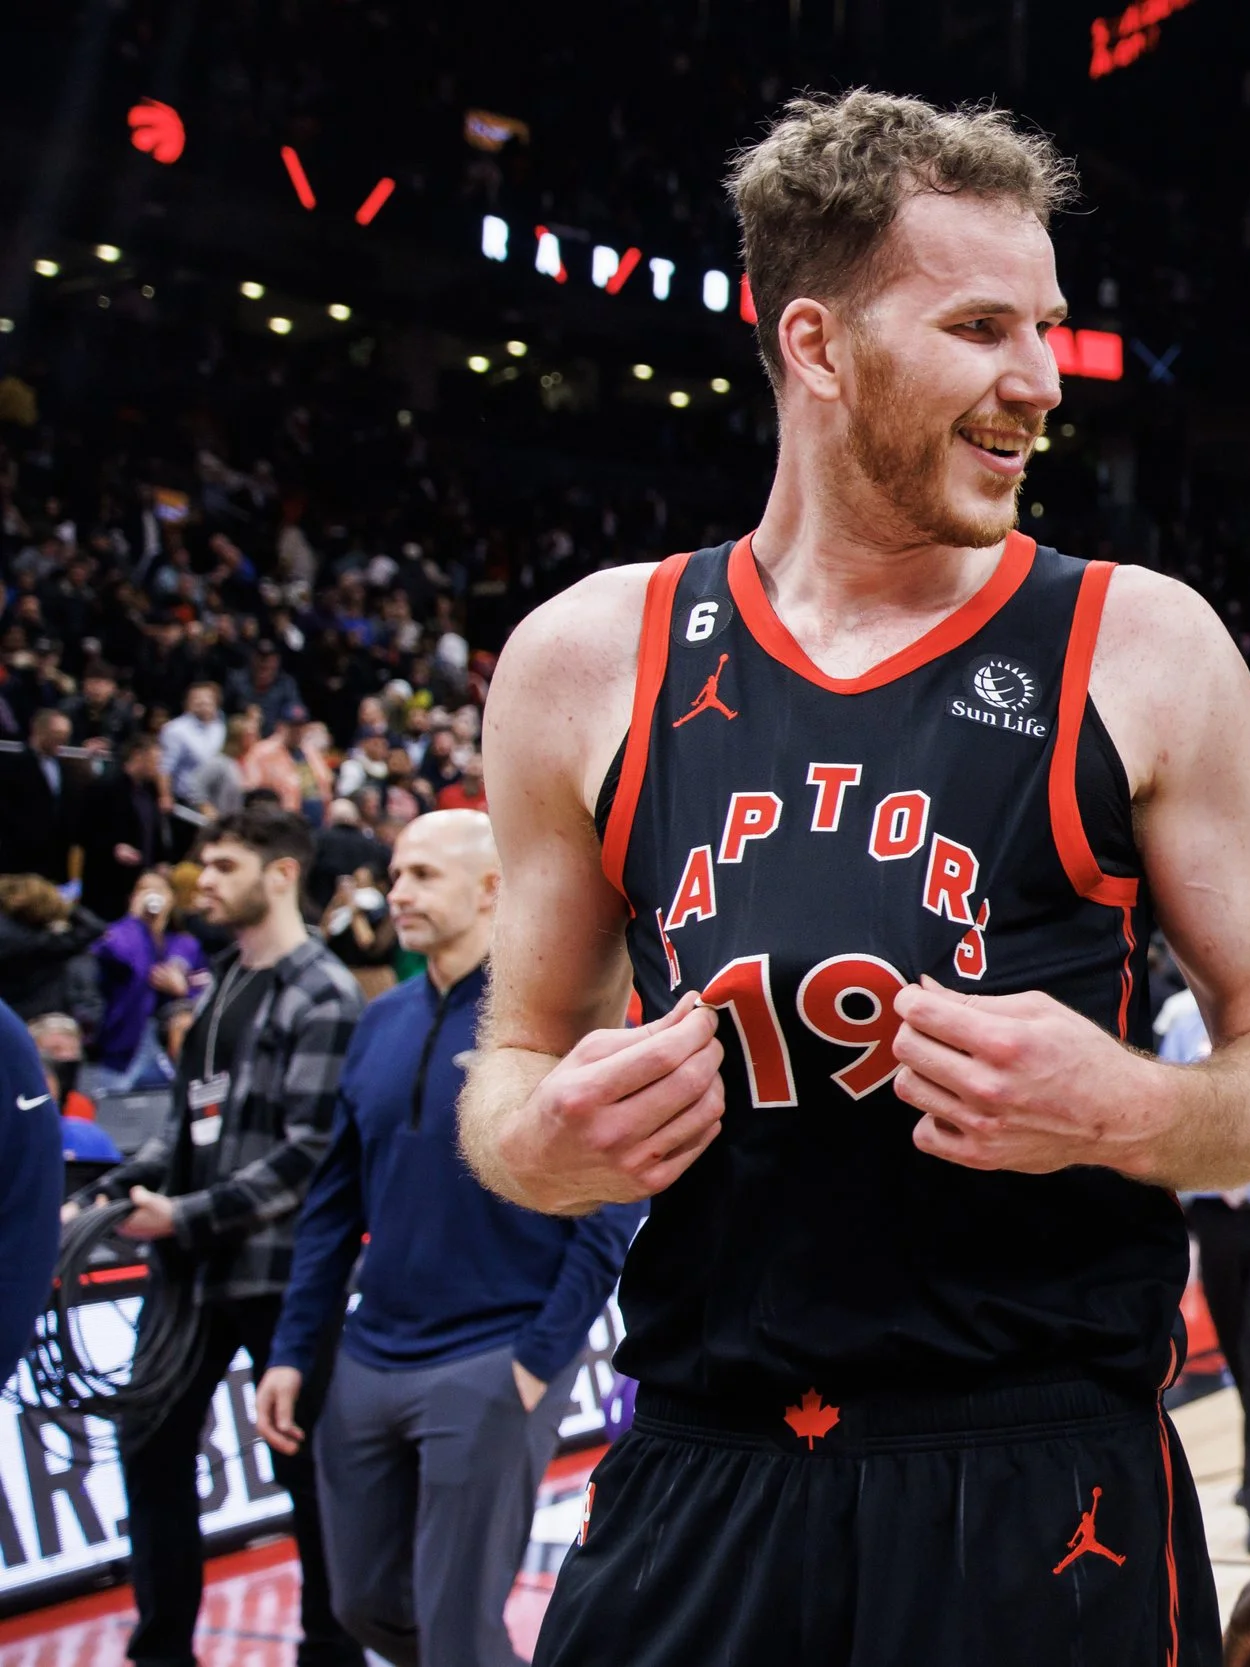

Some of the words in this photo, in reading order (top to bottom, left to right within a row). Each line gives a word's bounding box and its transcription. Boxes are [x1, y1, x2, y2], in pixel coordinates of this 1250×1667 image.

[685, 601, 720, 642] 6
[951, 700, 998, 726] Sun
[1002, 712, 1046, 737] Life
[695, 953, 910, 1109] 19
